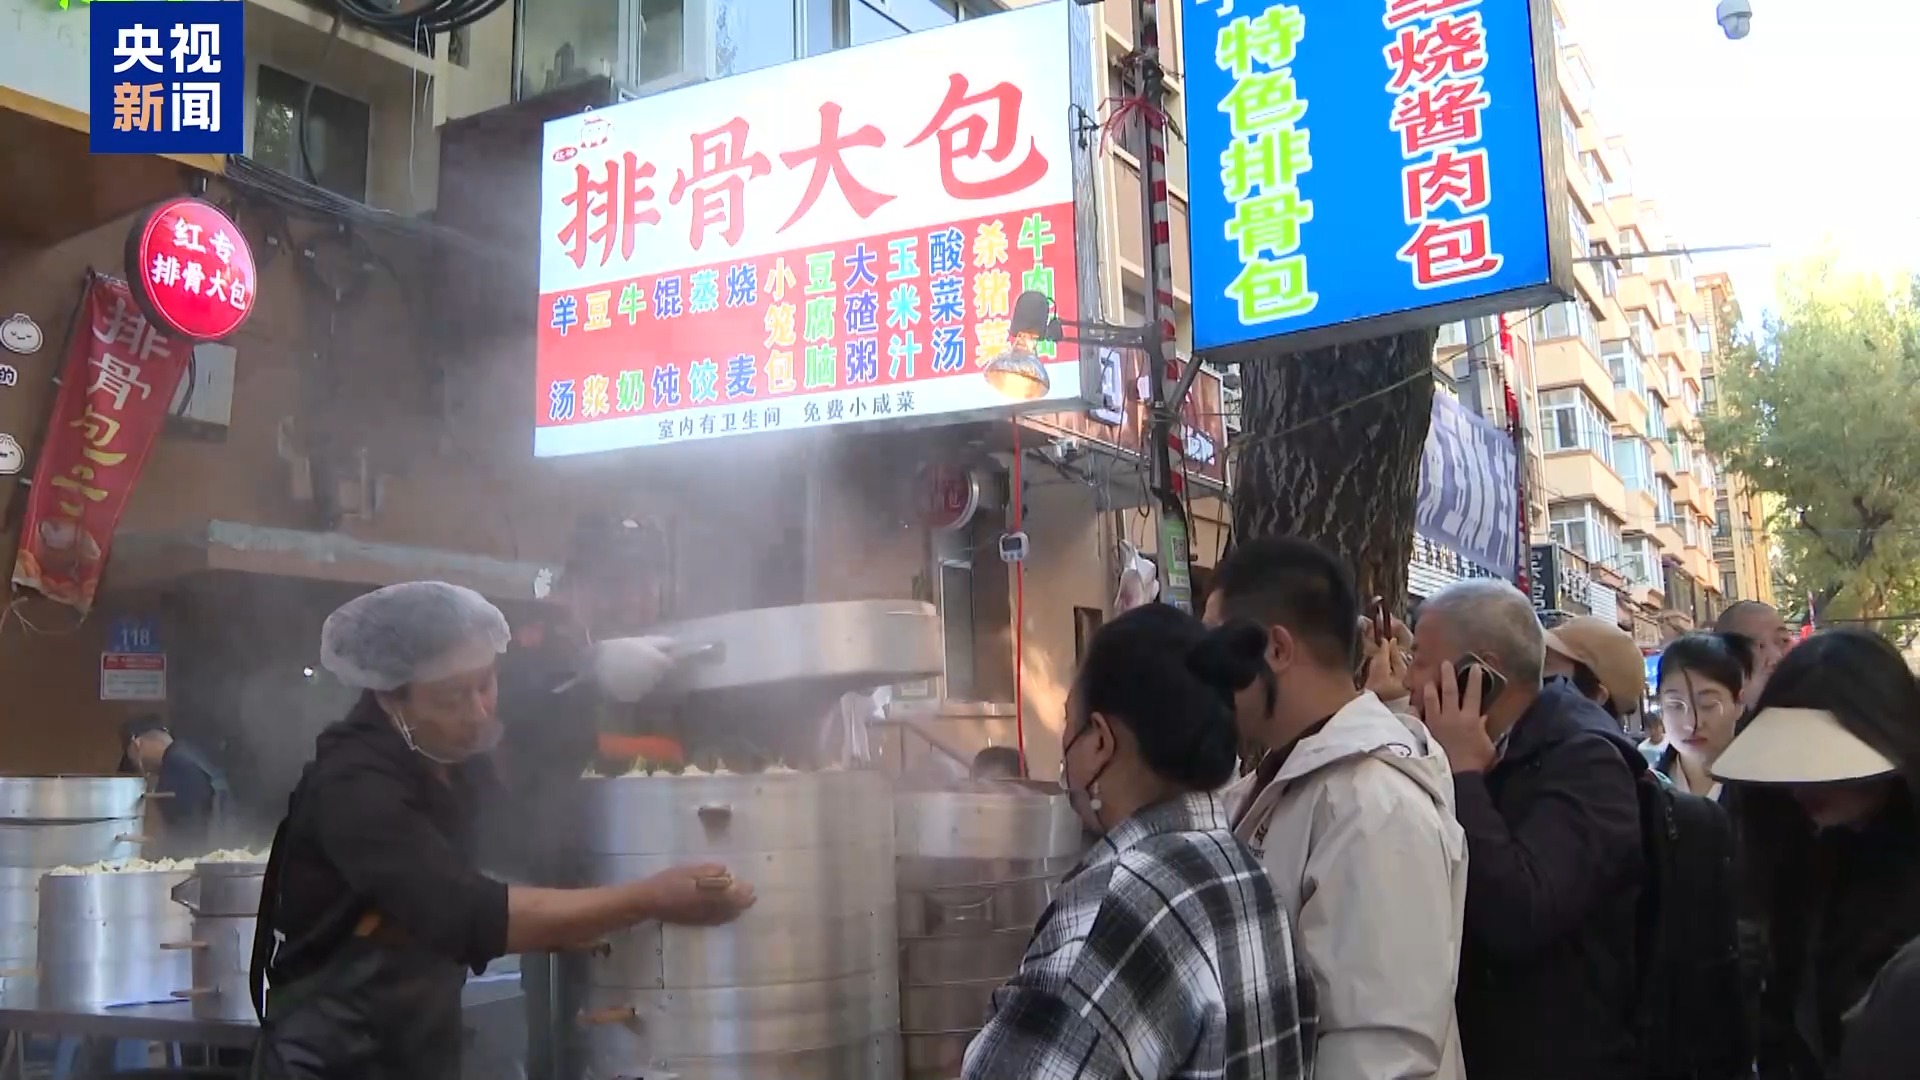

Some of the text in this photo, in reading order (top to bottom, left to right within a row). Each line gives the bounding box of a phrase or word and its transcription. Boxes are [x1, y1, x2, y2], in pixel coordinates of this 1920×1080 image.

[557, 73, 1049, 267] 排骨大包
[1197, 0, 1318, 325] 特色排骨包
[1385, 0, 1504, 289] 烧酱肉包
[151, 252, 246, 310] 排骨大包
[172, 217, 236, 264] 红专
[887, 236, 922, 378] 玉米汁
[929, 227, 966, 372] 酸菜汤
[973, 219, 1012, 368] 杀猪菜
[1018, 213, 1056, 358] 牛肉
[550, 296, 577, 420] 羊汤
[582, 289, 612, 415] 豆浆
[617, 283, 646, 411] 牛奶
[652, 276, 683, 408] 馄饨
[688, 269, 719, 402] 蒸饺
[726, 264, 757, 397] 烧麦
[764, 257, 797, 393] 小笼包
[804, 250, 836, 388] 豆腐脑
[845, 243, 879, 383] 大碴粥
[658, 390, 916, 441] 室内有卫生间 免费小咸菜
